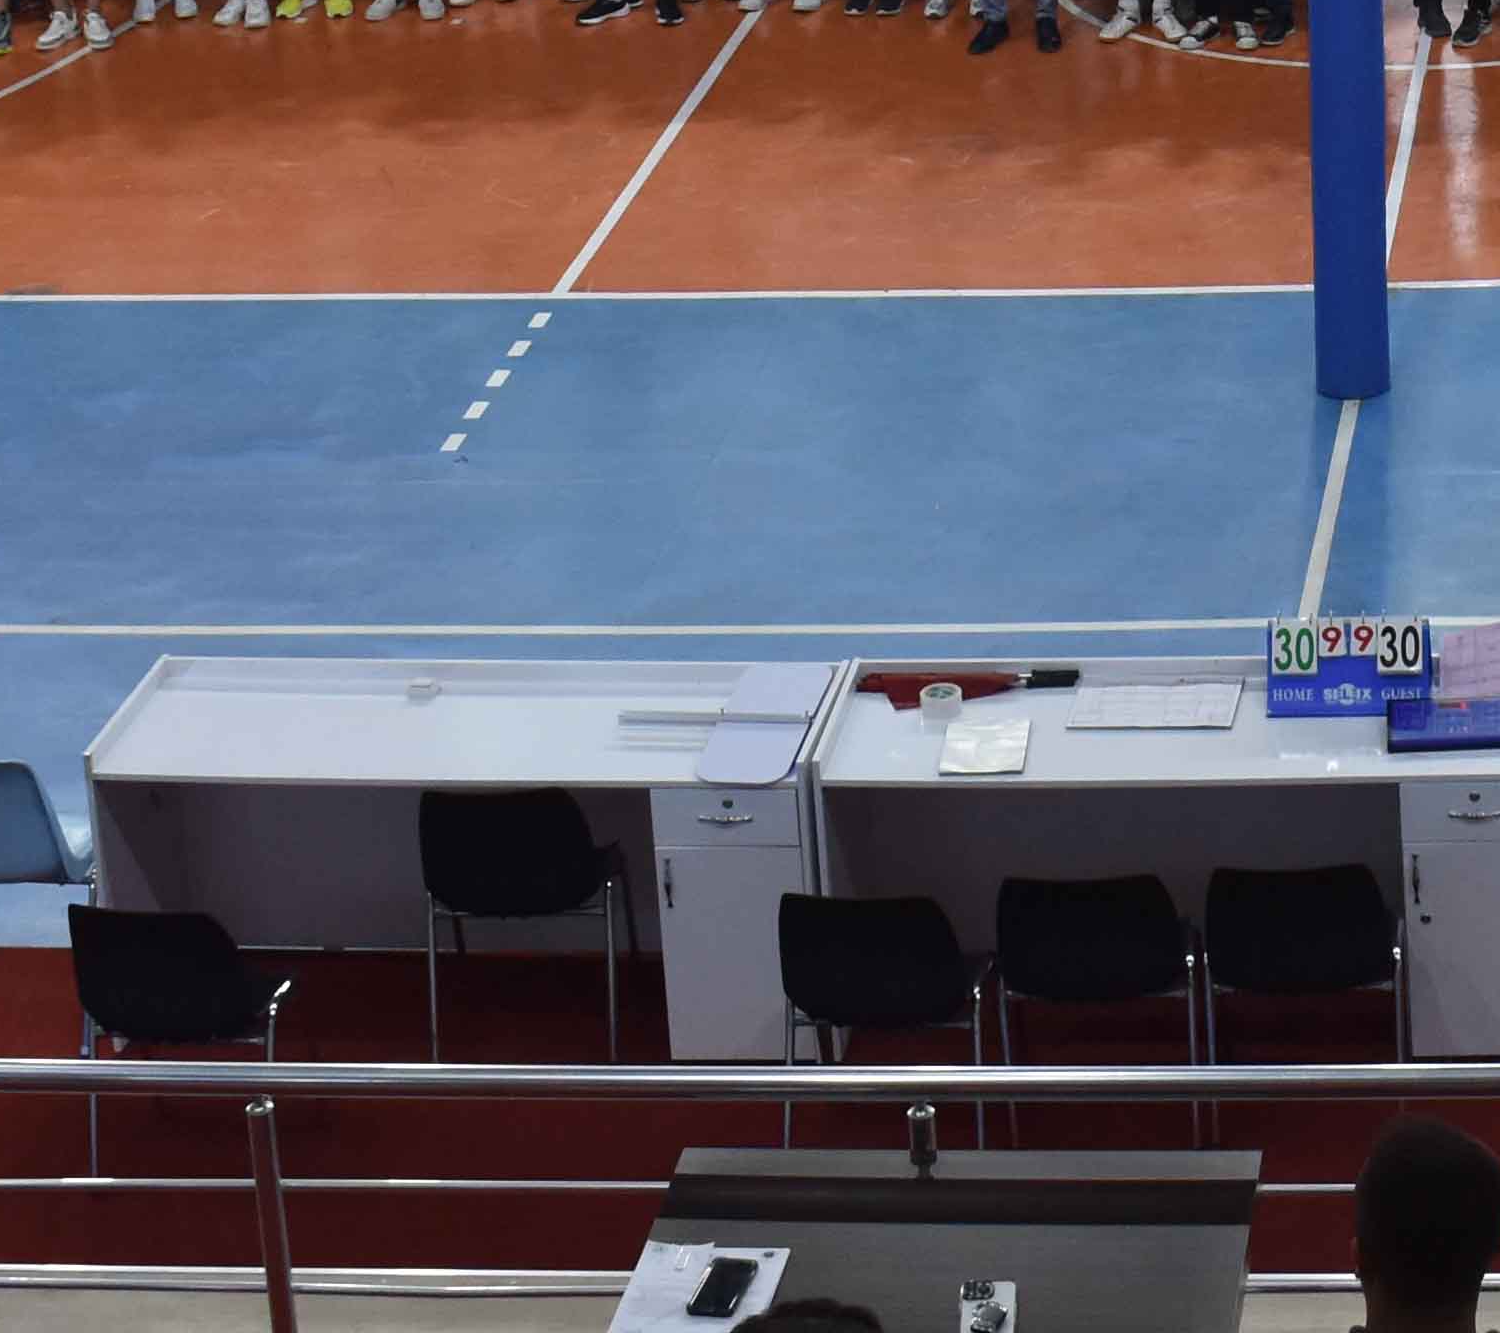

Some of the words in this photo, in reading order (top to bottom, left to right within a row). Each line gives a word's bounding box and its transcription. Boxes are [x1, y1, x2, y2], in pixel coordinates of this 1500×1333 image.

[1274, 626, 1315, 671] 30
[1321, 626, 1342, 653] 9
[1354, 624, 1374, 653] 9
[1380, 625, 1421, 668] 30
[1273, 688, 1315, 701] HOME
[1381, 686, 1422, 701] GUEST
